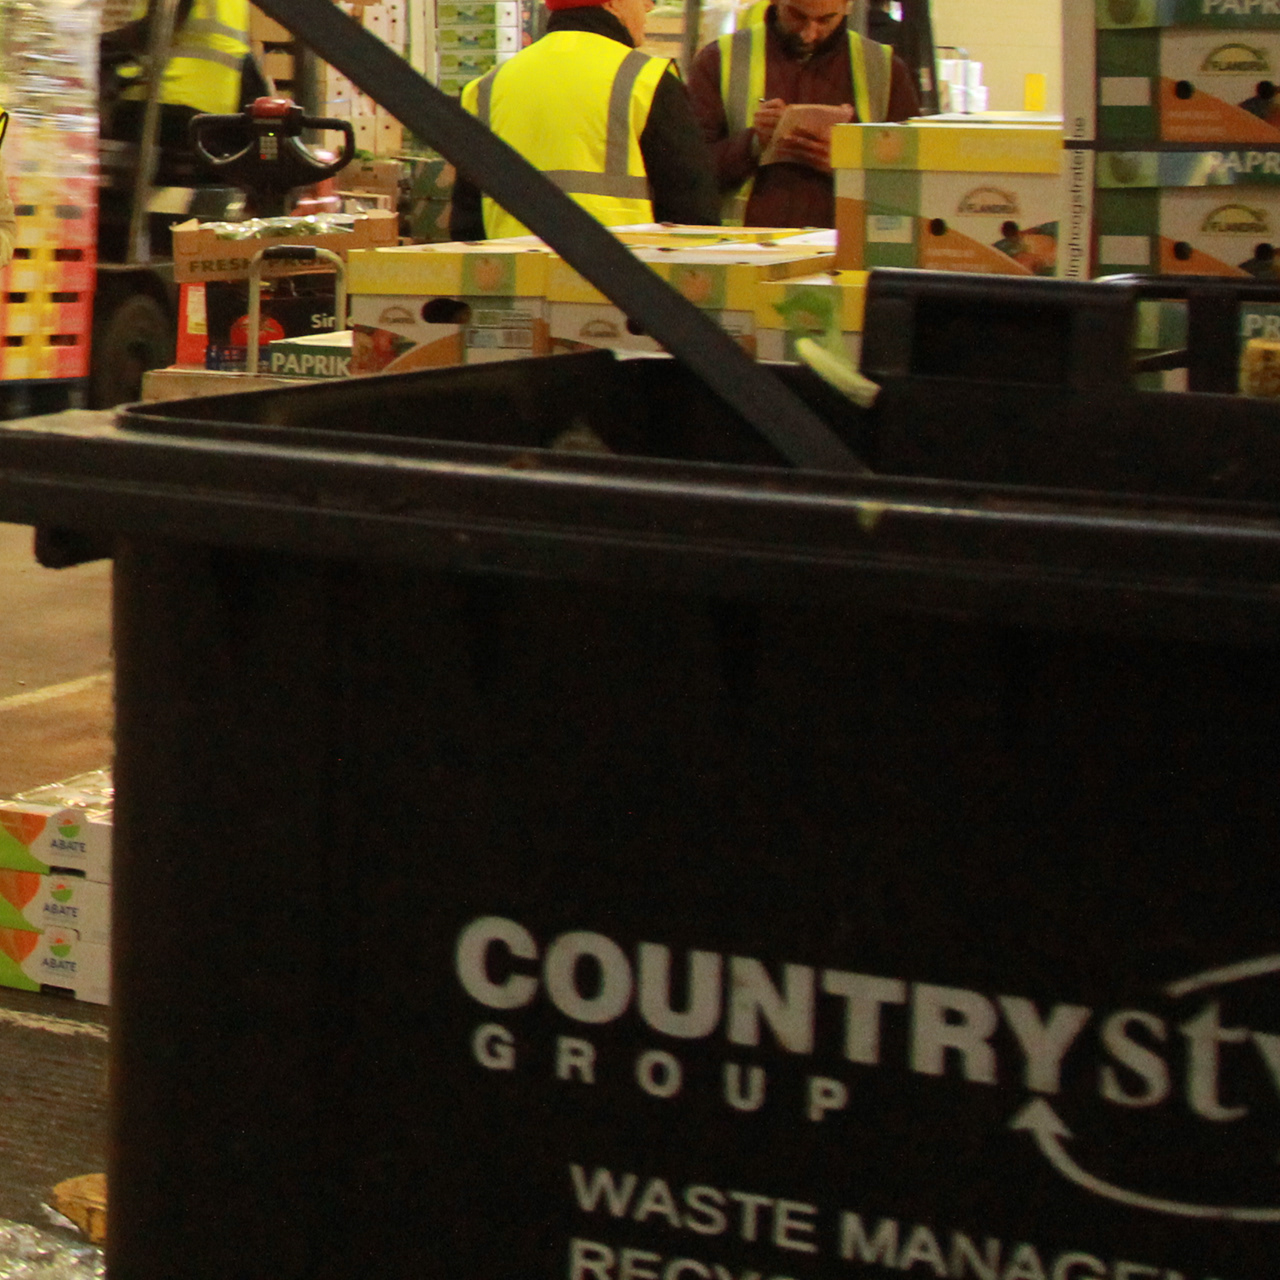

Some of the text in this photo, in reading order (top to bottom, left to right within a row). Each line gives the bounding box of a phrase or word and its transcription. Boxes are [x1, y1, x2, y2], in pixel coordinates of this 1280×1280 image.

[1208, 152, 1280, 174] PAPR
[271, 352, 352, 376] PAPRIK
[50, 838, 87, 853] ABATE
[43, 903, 78, 918] ABATE
[42, 957, 77, 972] ABATE
[471, 1022, 849, 1122] GROUP
[569, 1162, 819, 1254] WASTE
